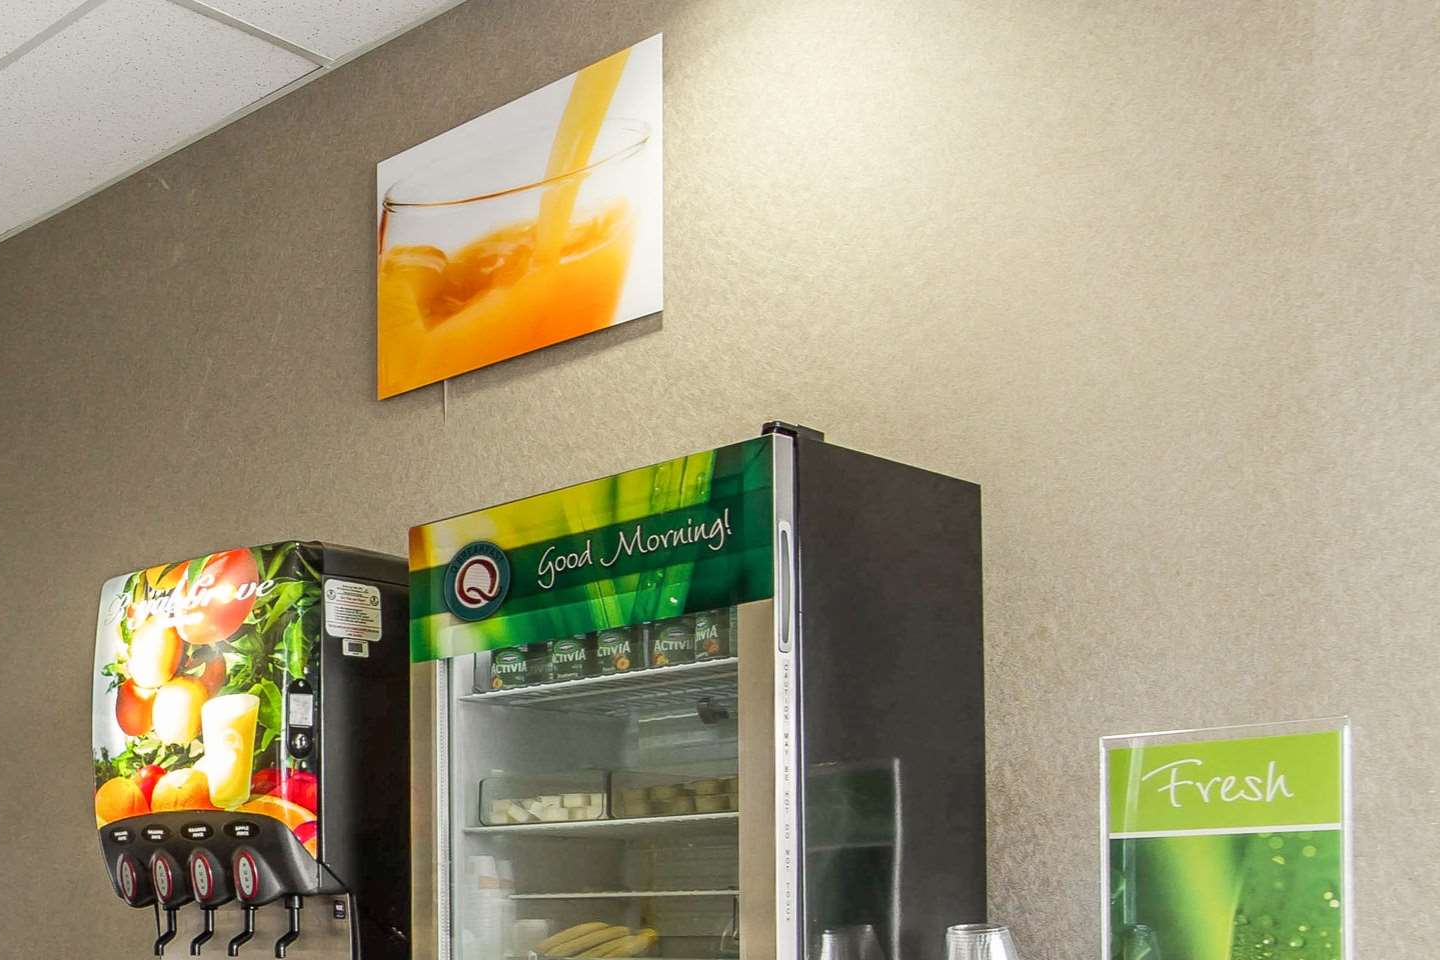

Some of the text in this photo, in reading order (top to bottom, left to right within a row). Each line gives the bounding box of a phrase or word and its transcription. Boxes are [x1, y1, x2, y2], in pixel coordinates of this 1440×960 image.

[537, 508, 733, 590] Good Morning!
[551, 648, 587, 664] CTIVIA
[596, 640, 631, 657] CTIVIA
[490, 661, 528, 675] ACTIVIA
[1141, 758, 1294, 809] Fresh
